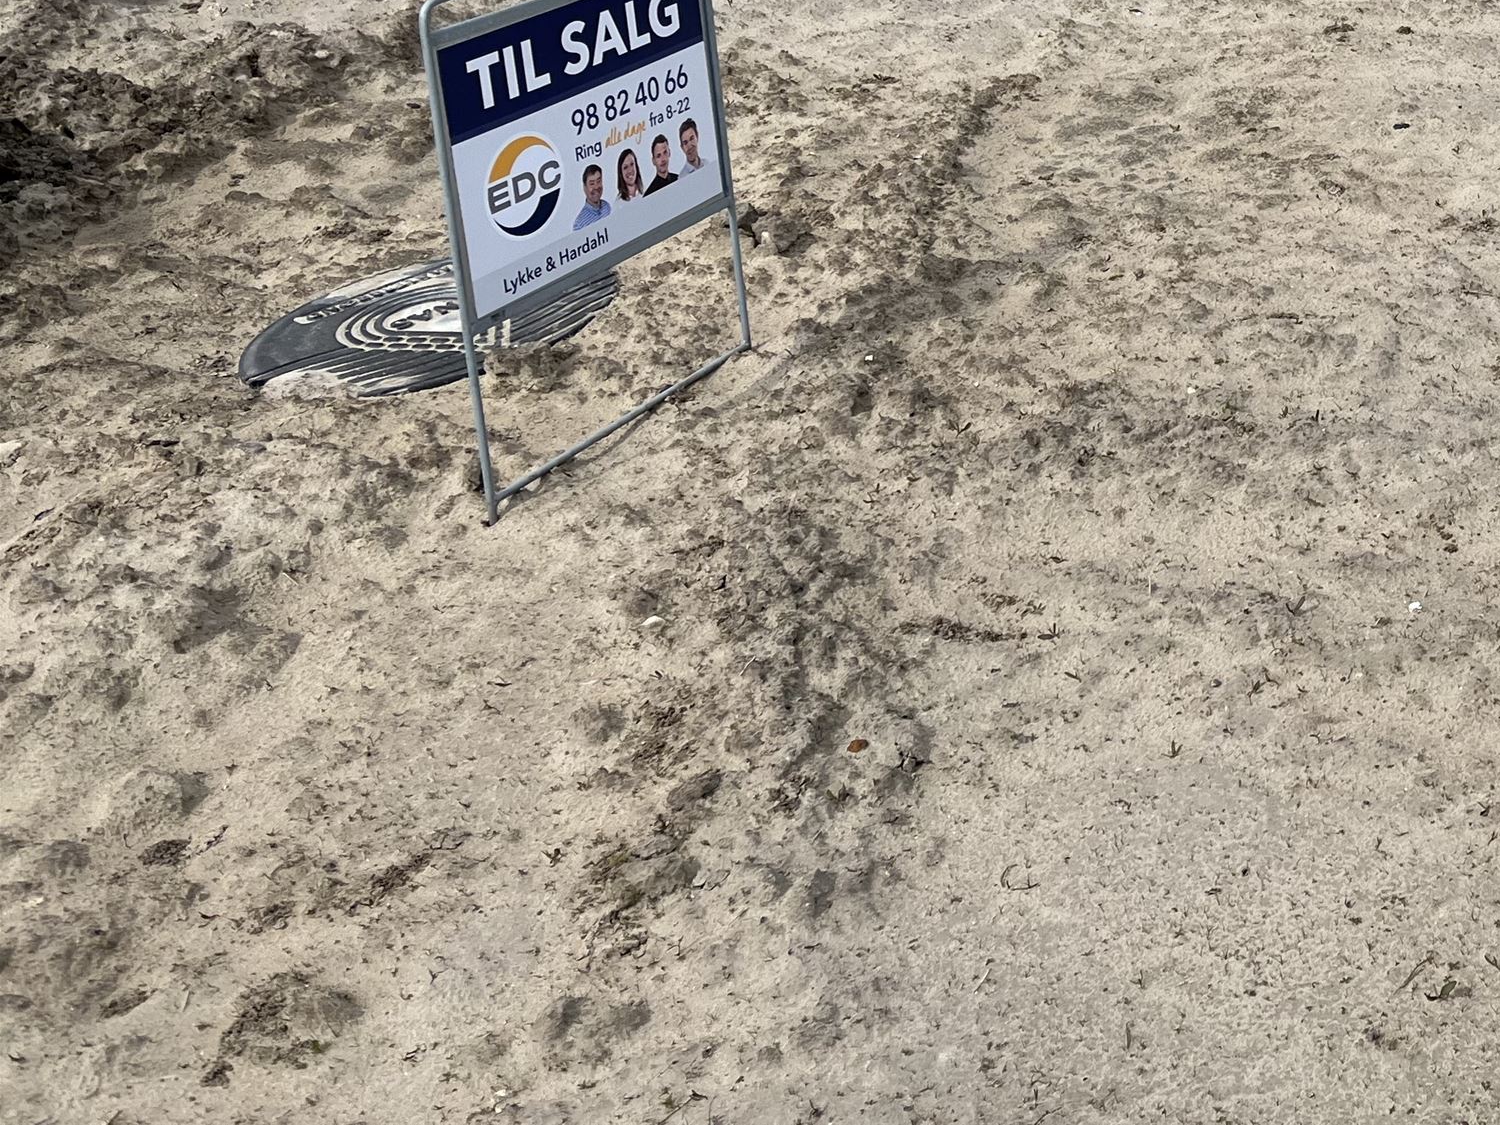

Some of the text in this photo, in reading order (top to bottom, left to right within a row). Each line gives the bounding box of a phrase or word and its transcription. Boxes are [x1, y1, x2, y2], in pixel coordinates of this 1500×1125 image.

[465, 38, 552, 110] TIL
[571, 63, 689, 136] 98 82 40 66
[575, 96, 691, 162] Ring alle dage fra 8-22
[487, 160, 562, 215] EDC
[503, 227, 610, 295] Lykke & Hardahl
